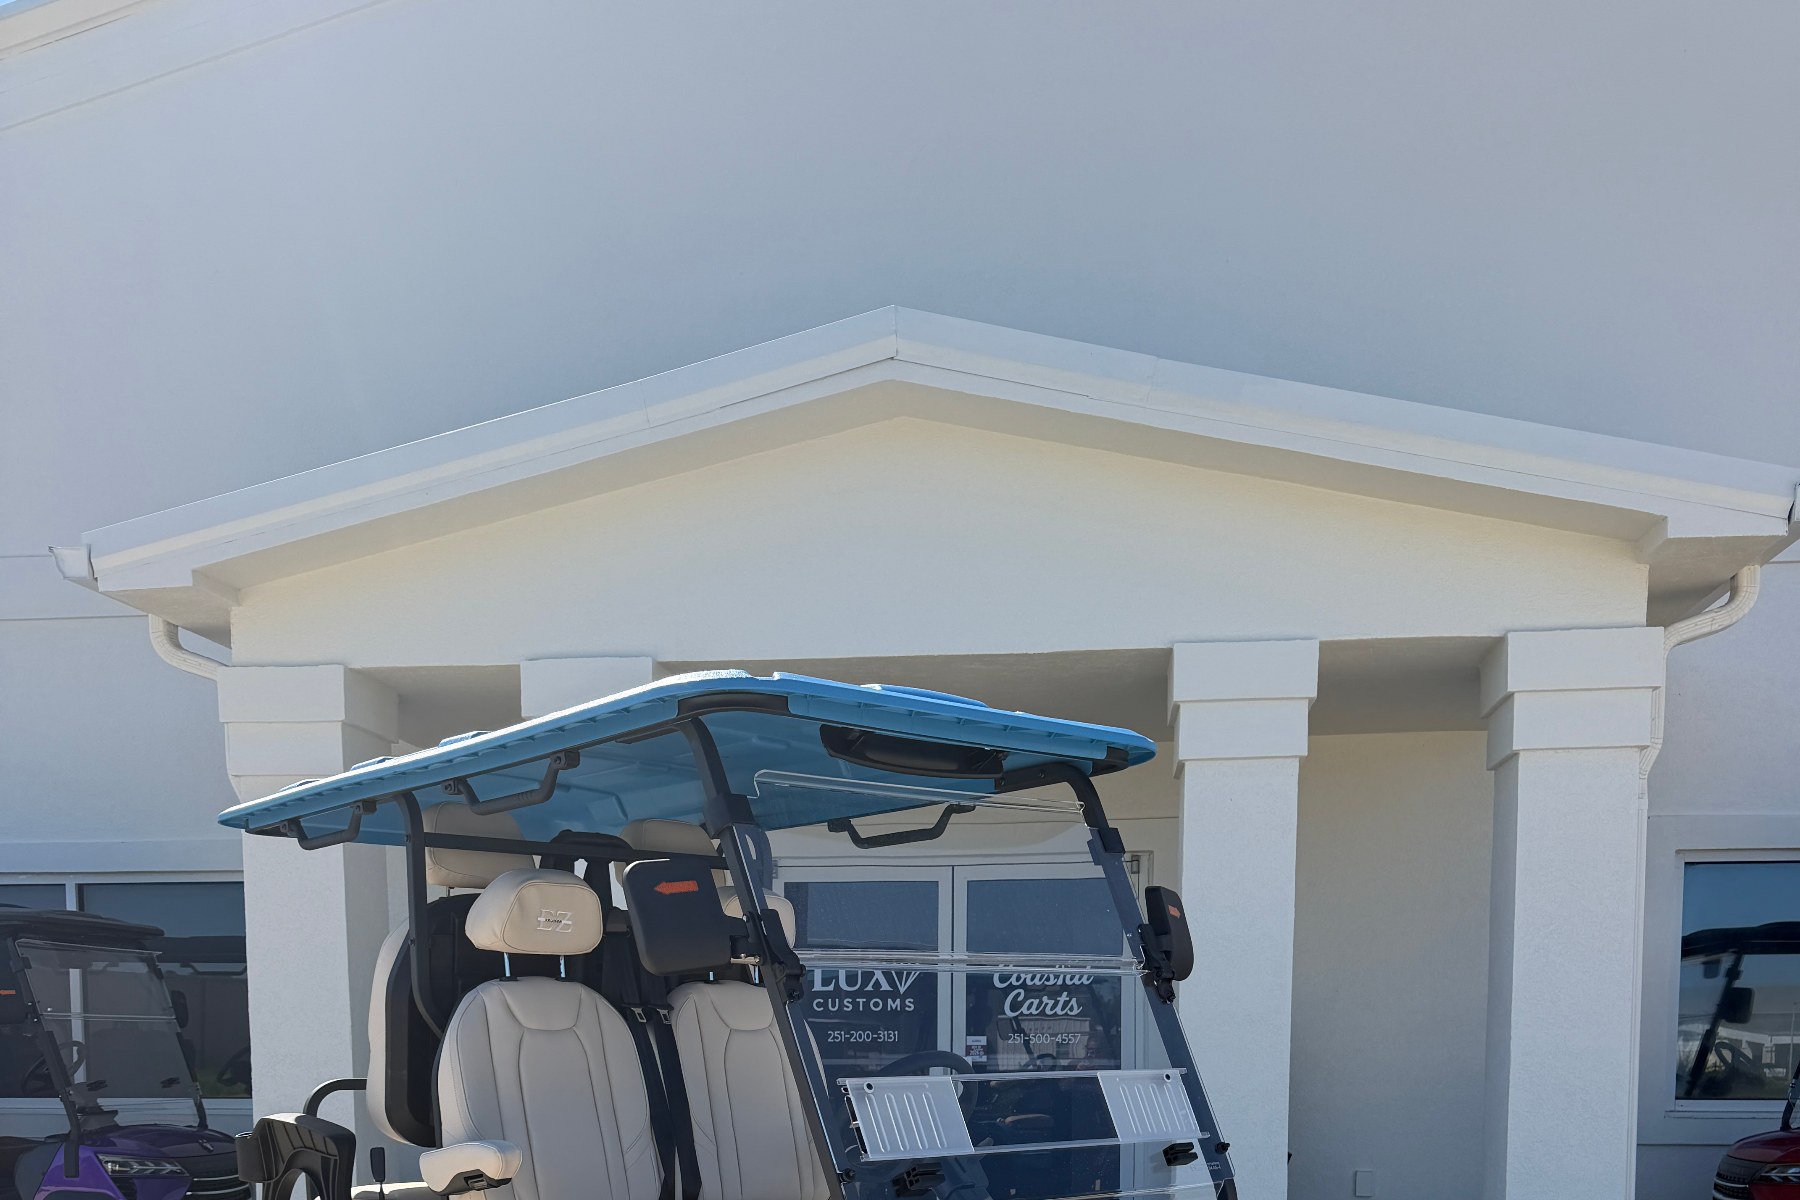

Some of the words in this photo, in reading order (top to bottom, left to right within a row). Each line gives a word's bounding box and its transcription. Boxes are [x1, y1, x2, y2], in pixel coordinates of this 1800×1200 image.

[536, 909, 572, 933] EZ
[812, 998, 915, 1012] CUSTOMS
[1004, 988, 1083, 1018] Carts
[827, 1030, 899, 1042] 251-200-3131
[1008, 1033, 1081, 1044] 251-500-4557
